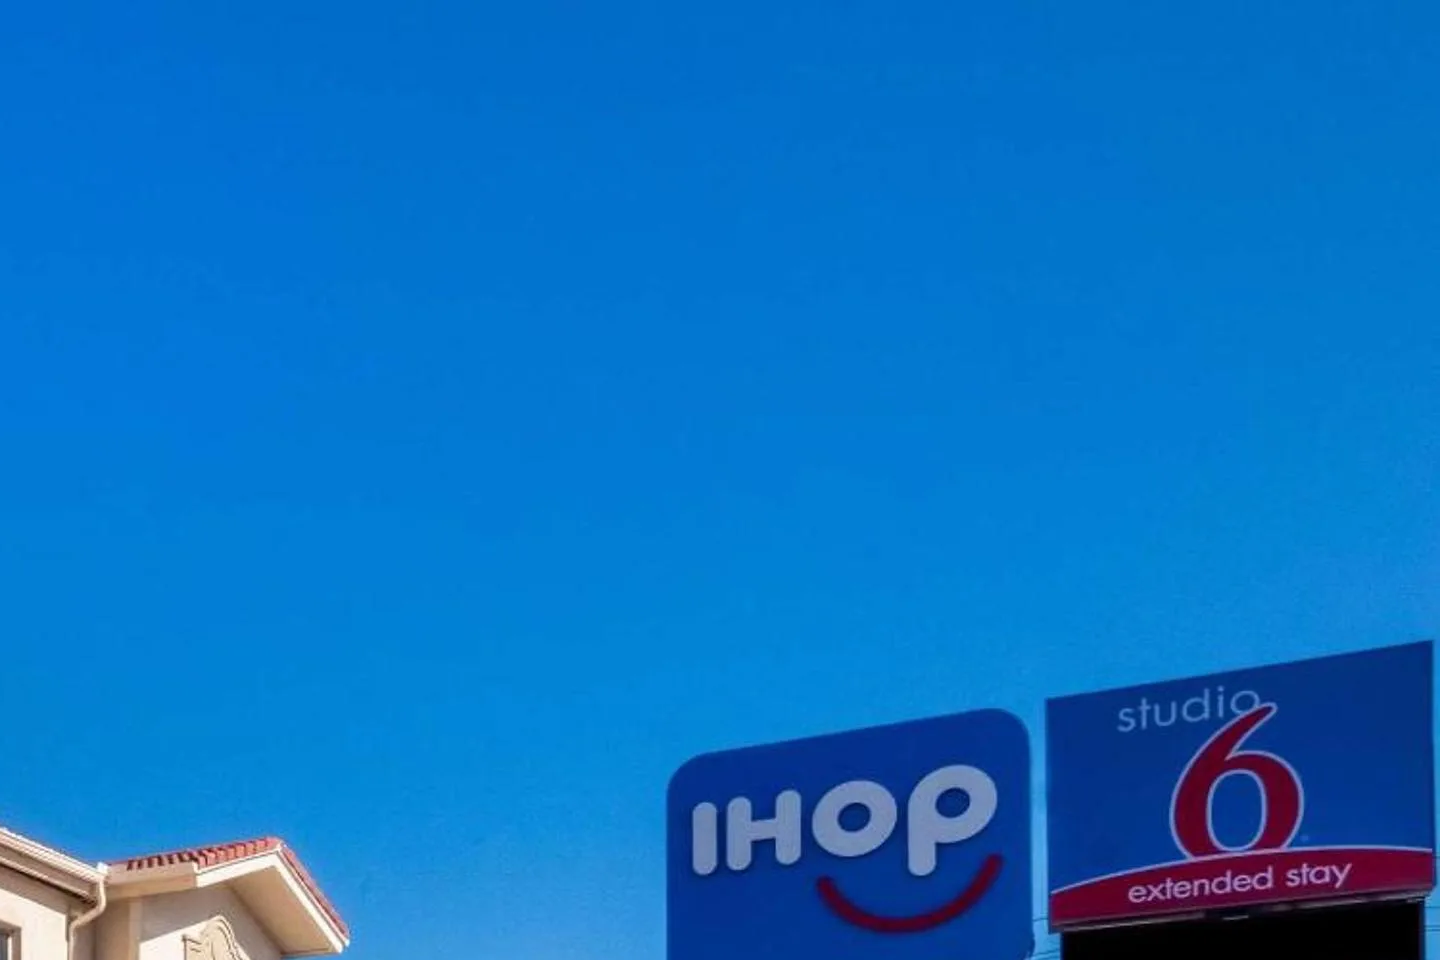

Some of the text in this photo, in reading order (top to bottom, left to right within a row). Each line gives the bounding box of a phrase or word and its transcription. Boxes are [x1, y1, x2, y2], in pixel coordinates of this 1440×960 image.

[1117, 685, 1261, 732] studio
[691, 764, 998, 877] IHOP
[1168, 702, 1305, 861] 6
[1127, 861, 1353, 903] extended stay
